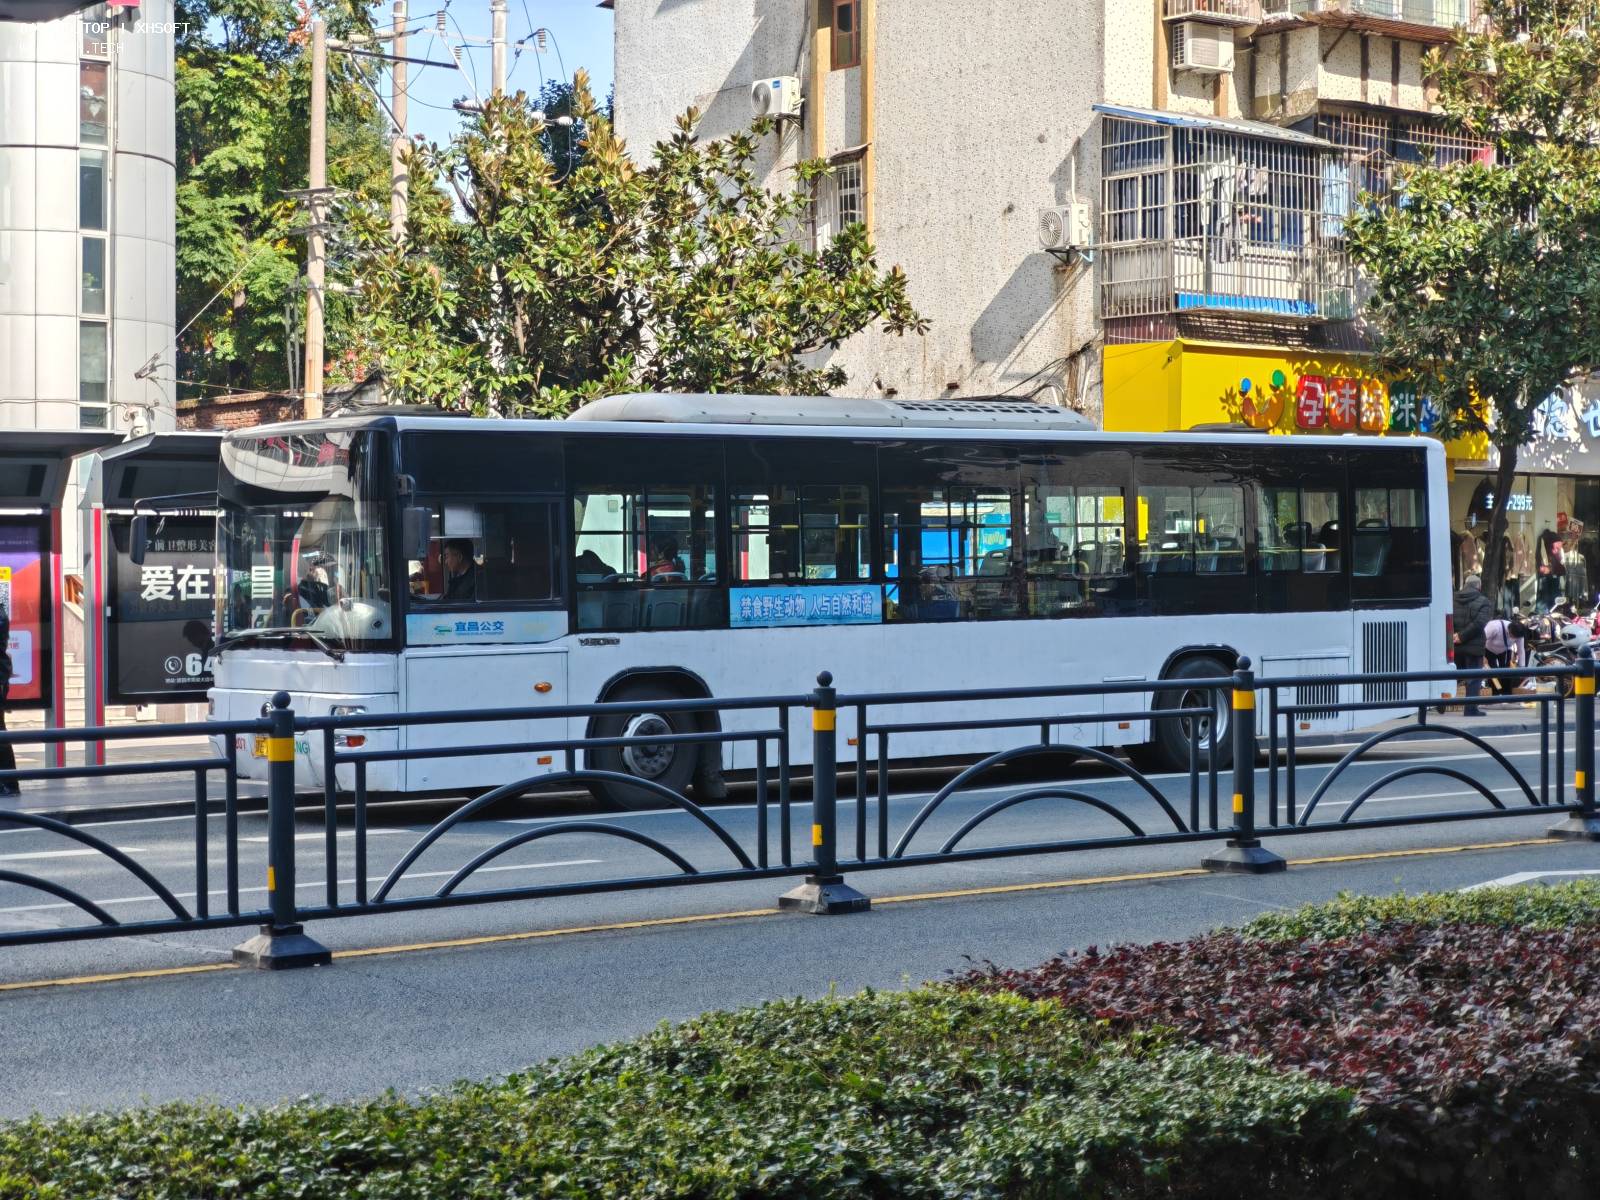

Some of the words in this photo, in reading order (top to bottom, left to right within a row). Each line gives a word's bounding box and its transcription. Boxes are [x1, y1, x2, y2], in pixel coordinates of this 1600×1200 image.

[740, 594, 806, 618] 禁食野生动物
[810, 592, 872, 617] 人与自然和谐
[454, 620, 504, 632] 宜昌公交
